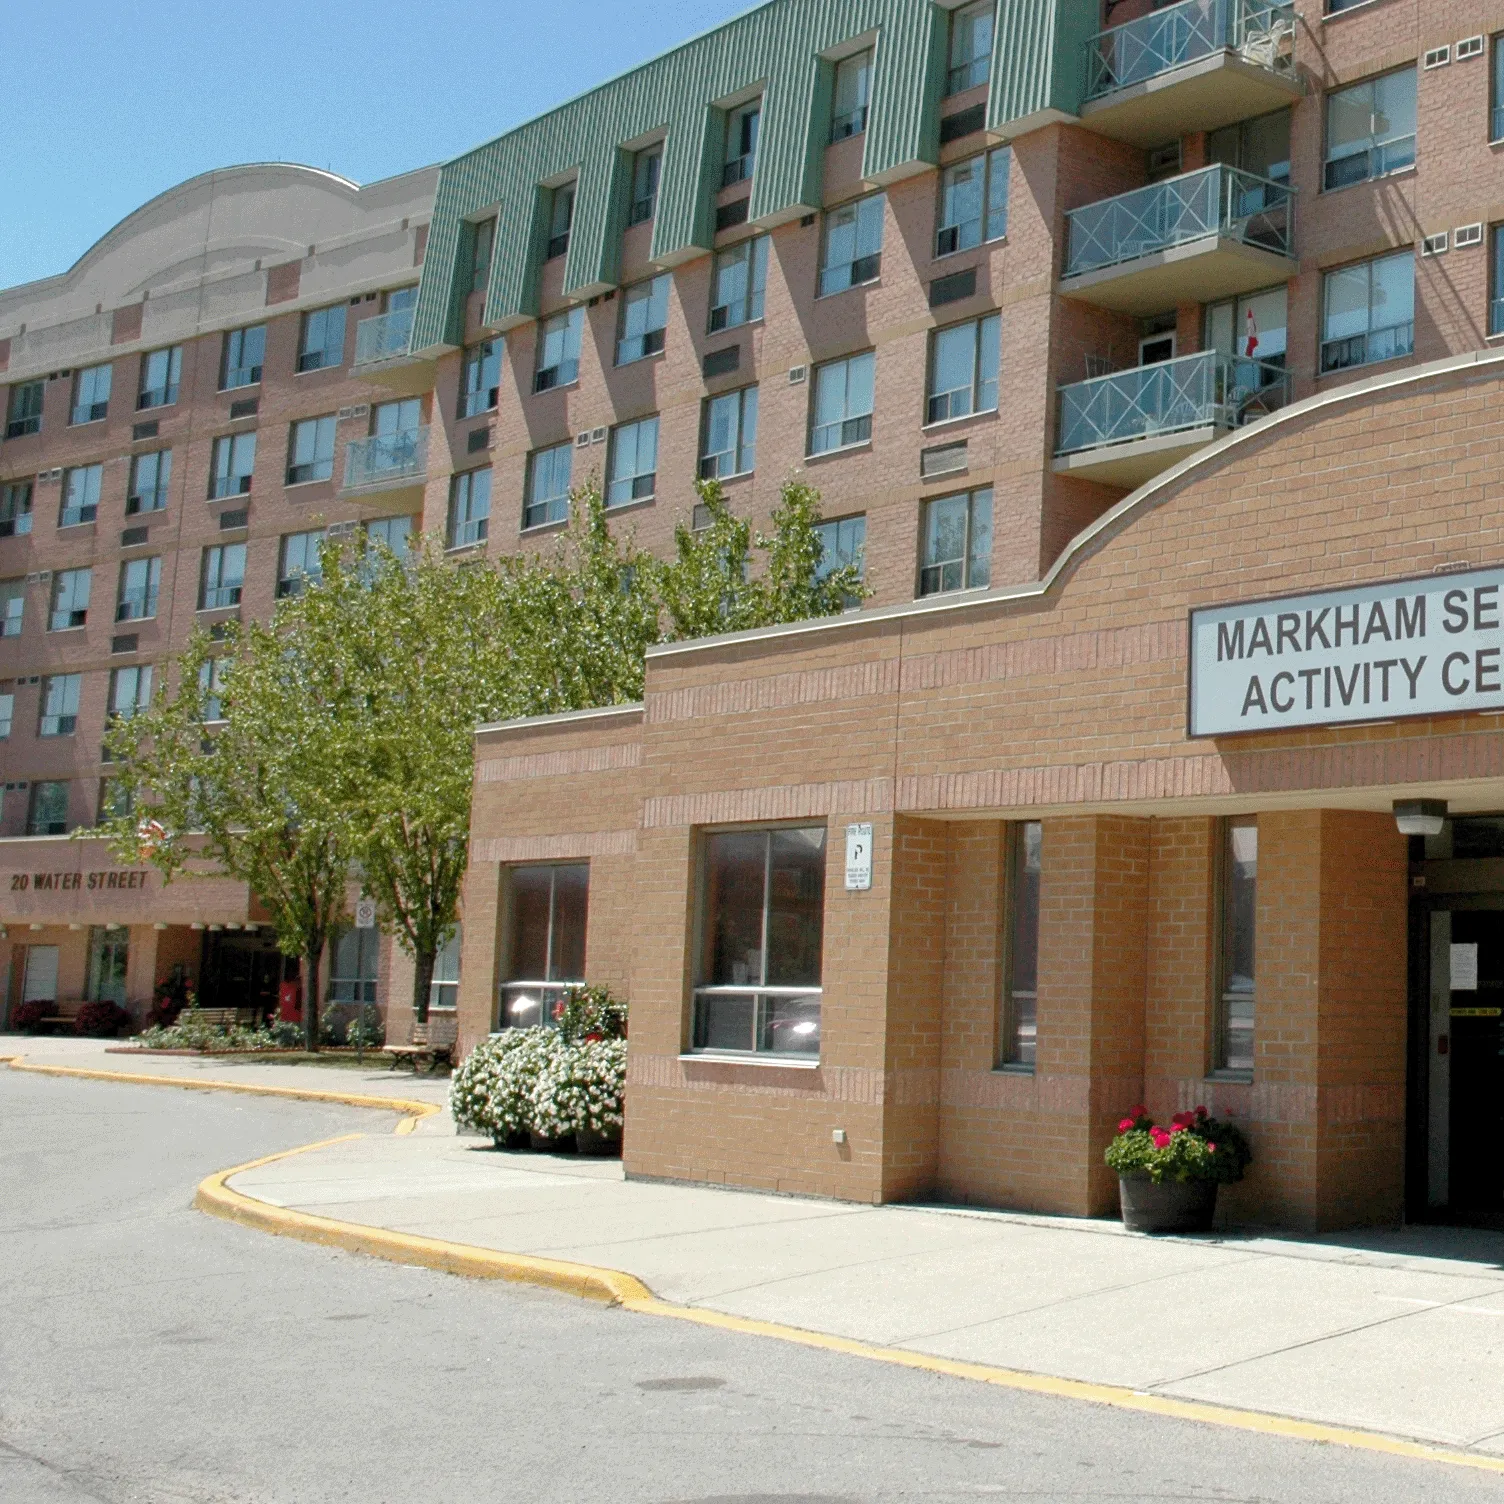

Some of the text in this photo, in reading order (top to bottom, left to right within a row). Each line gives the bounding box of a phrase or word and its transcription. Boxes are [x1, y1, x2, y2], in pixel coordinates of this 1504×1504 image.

[1217, 594, 1427, 662] MARKHAM
[1240, 655, 1428, 717] ACTIVITY
[11, 870, 149, 891] 20 WATER STREET
